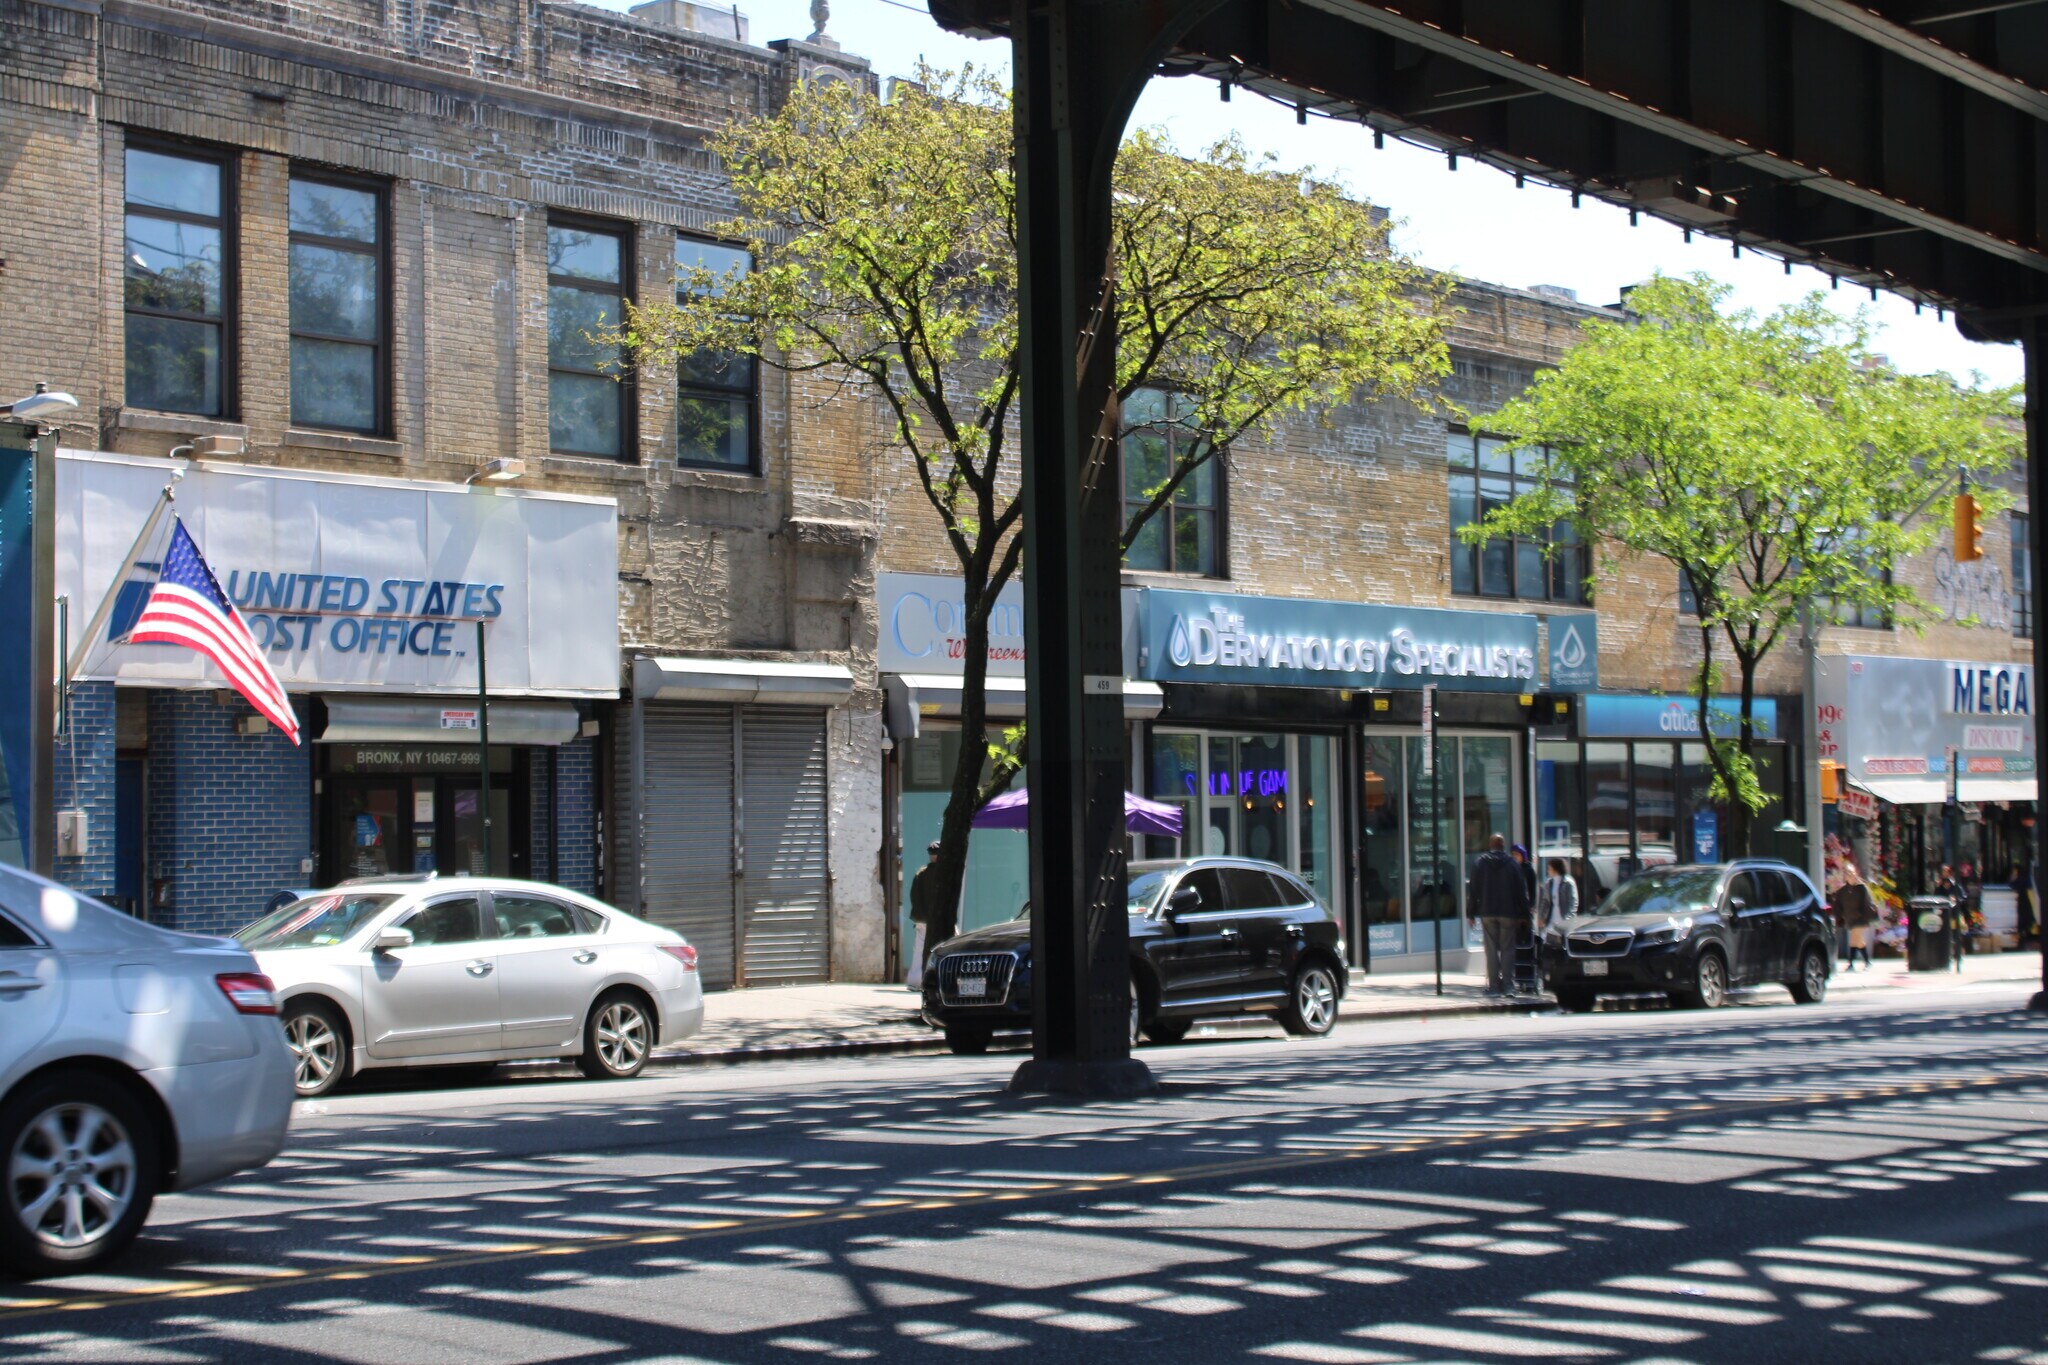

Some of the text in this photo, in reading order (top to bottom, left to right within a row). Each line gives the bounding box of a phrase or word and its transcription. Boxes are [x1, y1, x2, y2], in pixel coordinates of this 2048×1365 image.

[228, 570, 504, 618] UNITED STATES
[1210, 606, 1245, 634] THE
[248, 613, 456, 657] OST OFFICE
[1097, 680, 1110, 690] 459
[1953, 667, 2030, 715] MEGA
[356, 751, 481, 766] BRONX, NY 10467-999
[1845, 789, 1870, 809] ATM
